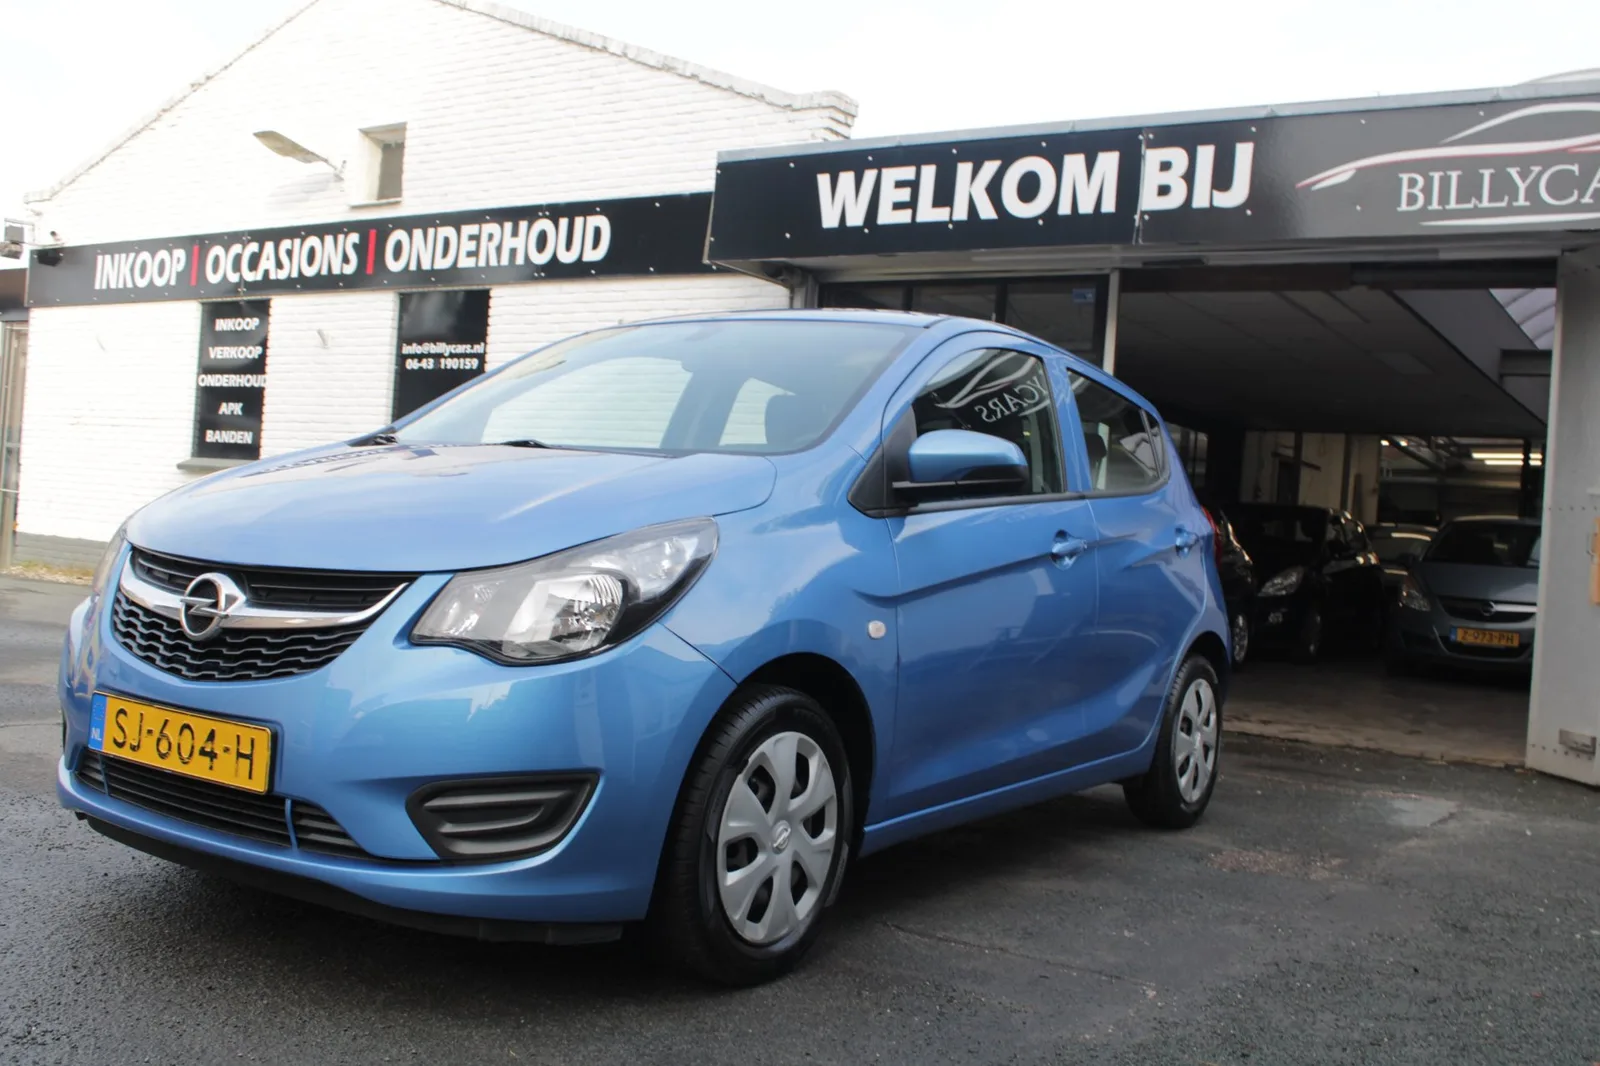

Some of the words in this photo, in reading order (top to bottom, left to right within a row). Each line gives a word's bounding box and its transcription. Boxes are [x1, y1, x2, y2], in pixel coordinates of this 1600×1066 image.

[816, 151, 1120, 229] WELKOM
[1141, 142, 1254, 212] BIJ
[94, 249, 186, 290] INKOOP
[205, 232, 360, 284] OCCASIONS
[384, 214, 612, 273] ONDERHOUD
[215, 318, 259, 331] INKOOP
[209, 346, 263, 359] VERKOOP
[401, 342, 485, 357] info@billycars.nl
[405, 358, 434, 370] 06-43
[440, 358, 479, 370] 190159
[198, 374, 268, 387] ONDERHOUD
[218, 402, 243, 415] APK
[205, 430, 253, 444] BANDEN
[91, 727, 102, 741] NL
[112, 707, 256, 781] SJ-604-H
